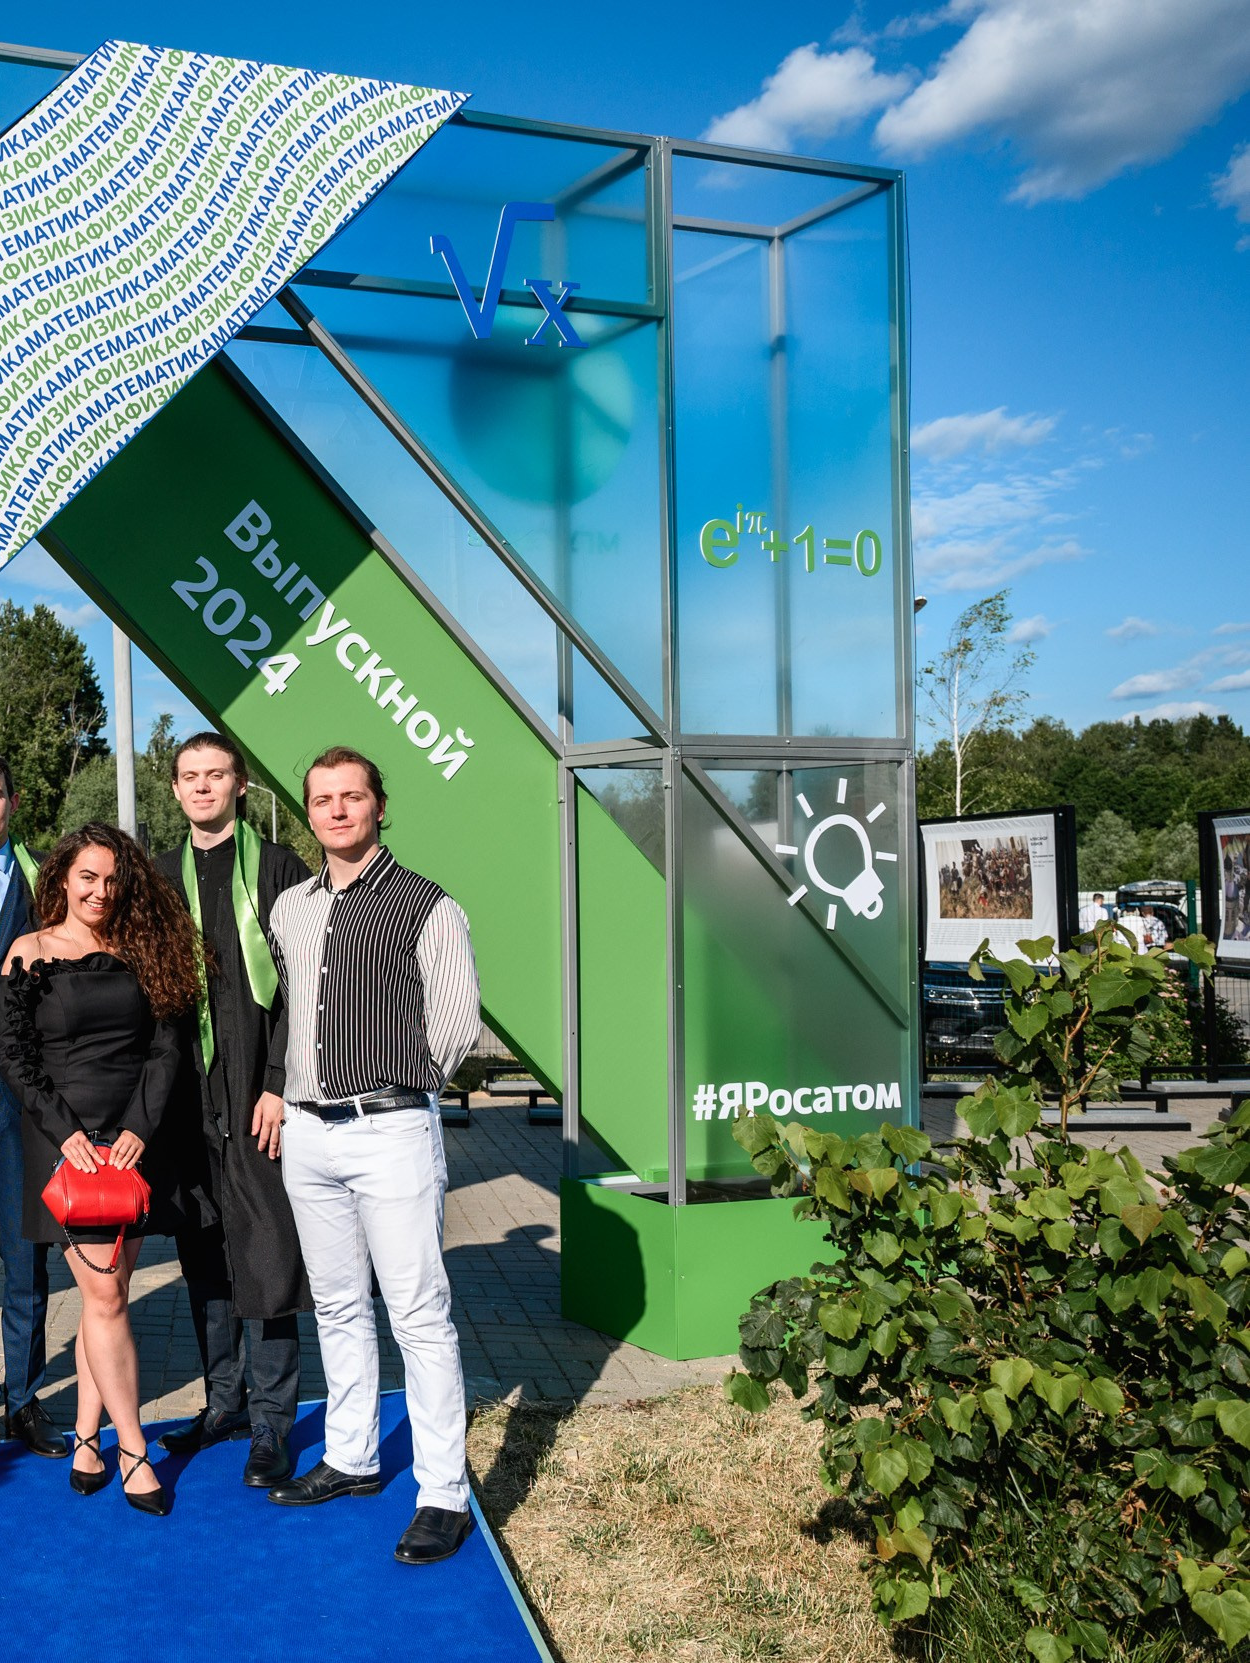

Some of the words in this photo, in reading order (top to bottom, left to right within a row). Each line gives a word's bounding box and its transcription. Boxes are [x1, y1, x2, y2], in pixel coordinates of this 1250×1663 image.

[171, 556, 301, 697] 2024
[223, 499, 475, 781] Выпускной
[693, 1081, 902, 1121] #ЯРосатом
